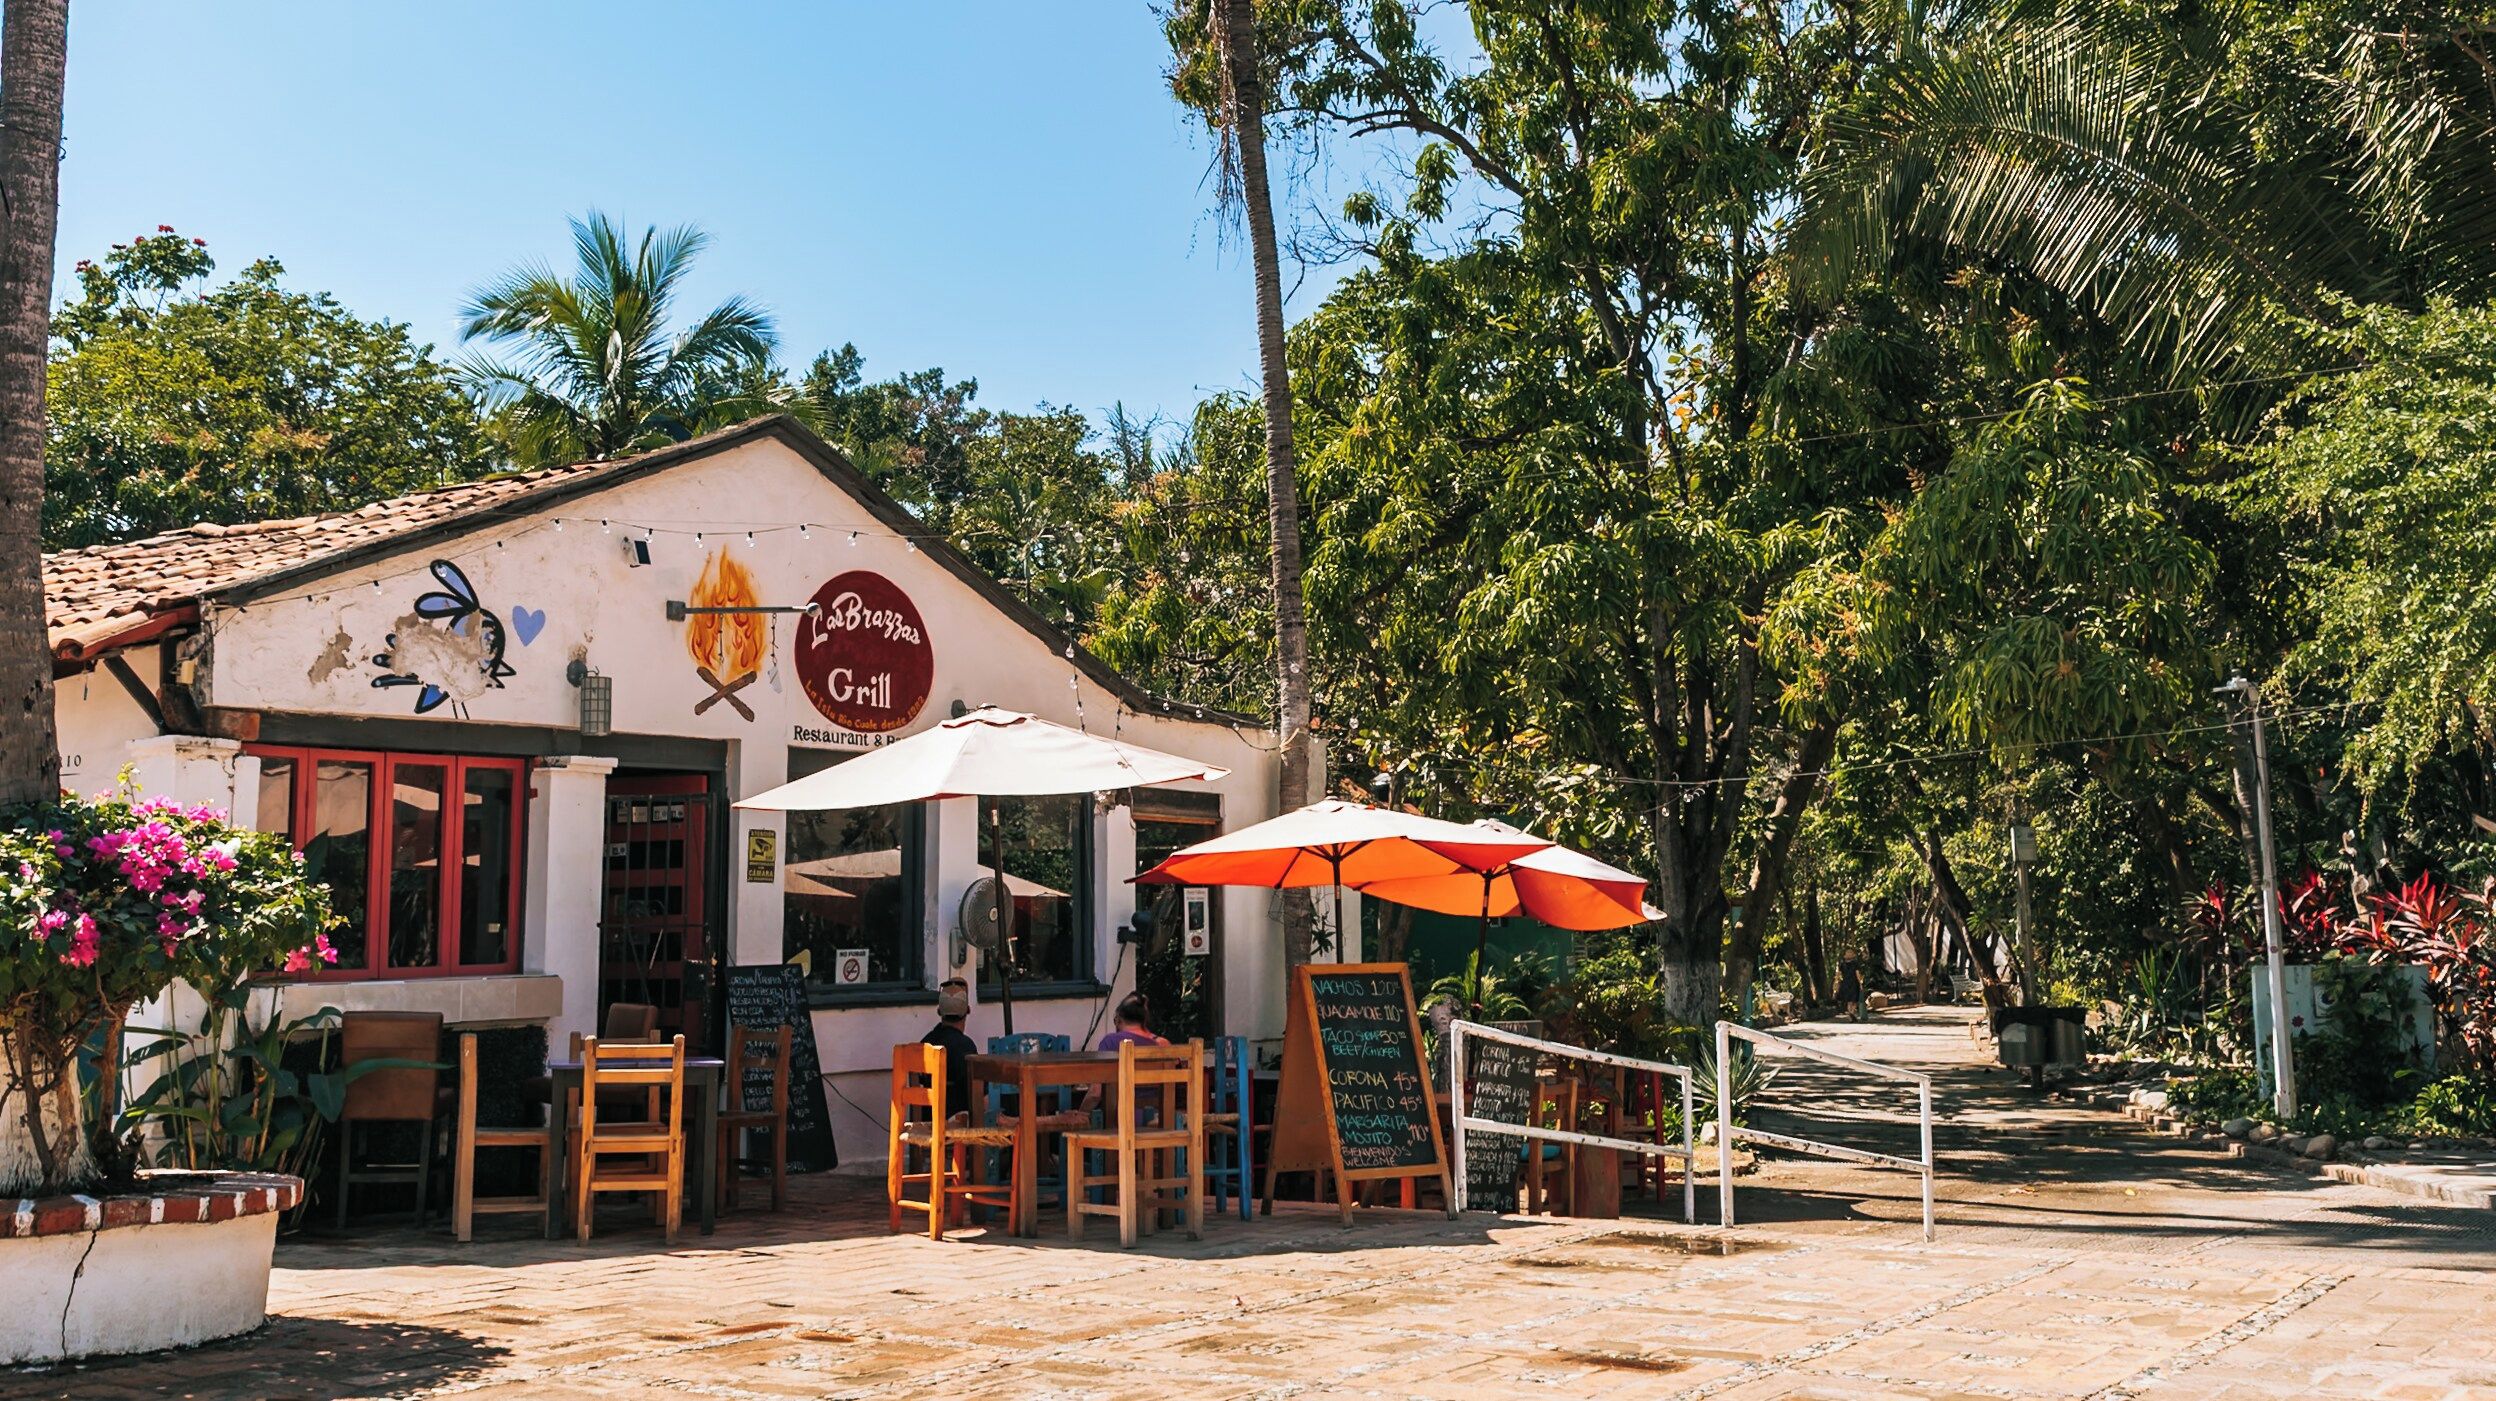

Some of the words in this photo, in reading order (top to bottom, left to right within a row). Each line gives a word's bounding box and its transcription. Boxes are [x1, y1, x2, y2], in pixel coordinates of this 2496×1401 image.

[806, 679, 817, 698] La
[828, 668, 891, 709] Grill
[794, 725, 869, 746] Restaurant
[874, 733, 882, 746] &
[1312, 979, 1364, 997] NACHOS
[1321, 1028, 1354, 1045] TACO
[1328, 1068, 1388, 1090] CORONA
[1334, 1091, 1394, 1111] PACIFICO
[1336, 1114, 1409, 1131] MARGARITA
[1344, 1131, 1392, 1146] MOJITO
